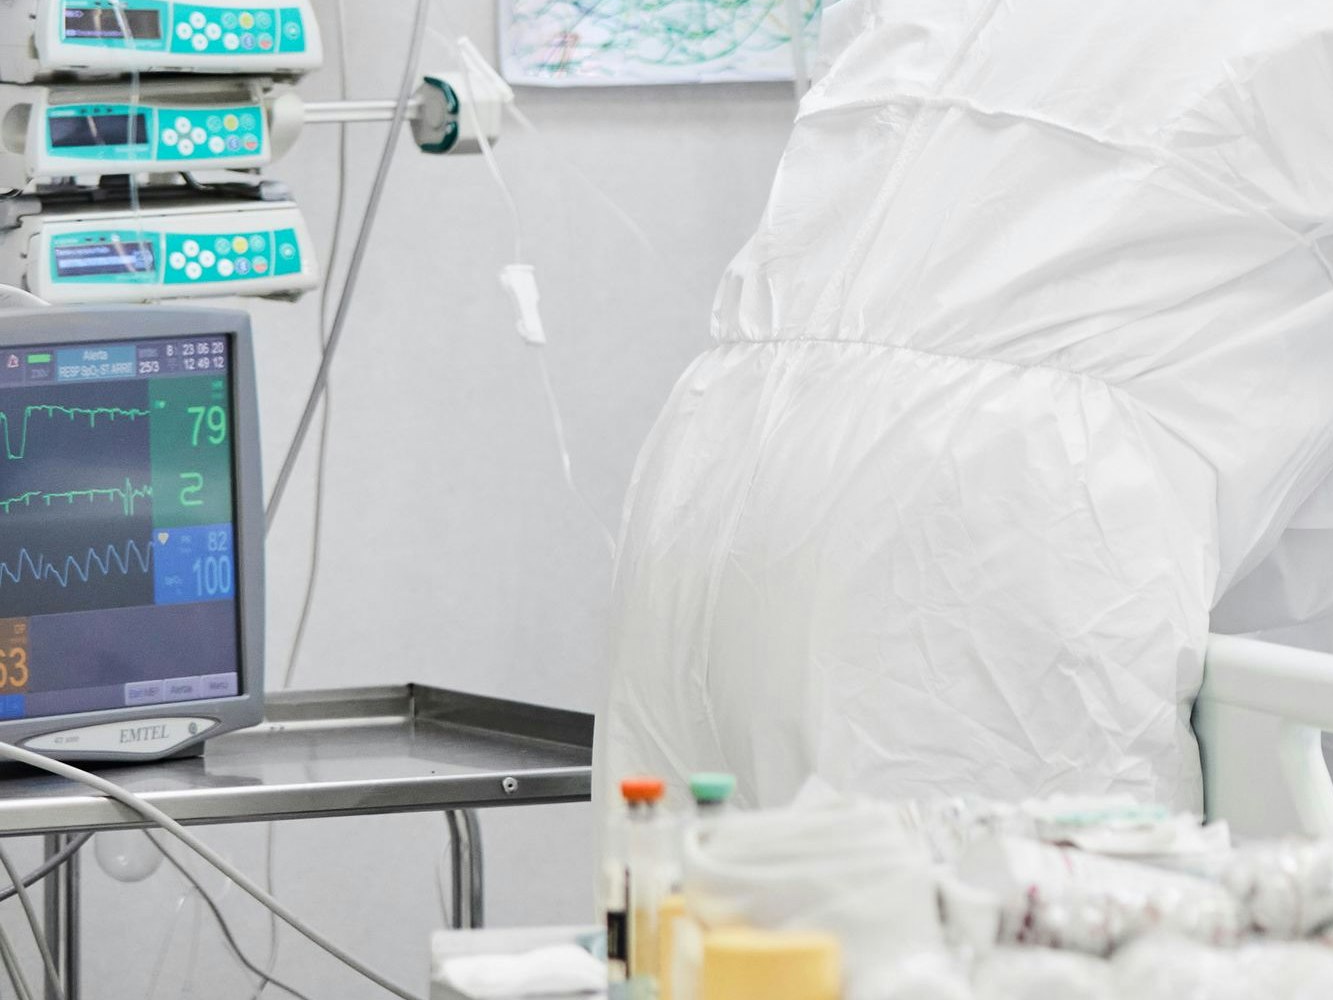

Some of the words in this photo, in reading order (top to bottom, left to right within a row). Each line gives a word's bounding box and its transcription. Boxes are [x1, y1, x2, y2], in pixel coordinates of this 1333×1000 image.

[187, 405, 227, 446] 79
[180, 472, 204, 506] 2
[207, 531, 228, 552] 82
[192, 554, 231, 596] 100
[119, 724, 170, 744] EMTEL
